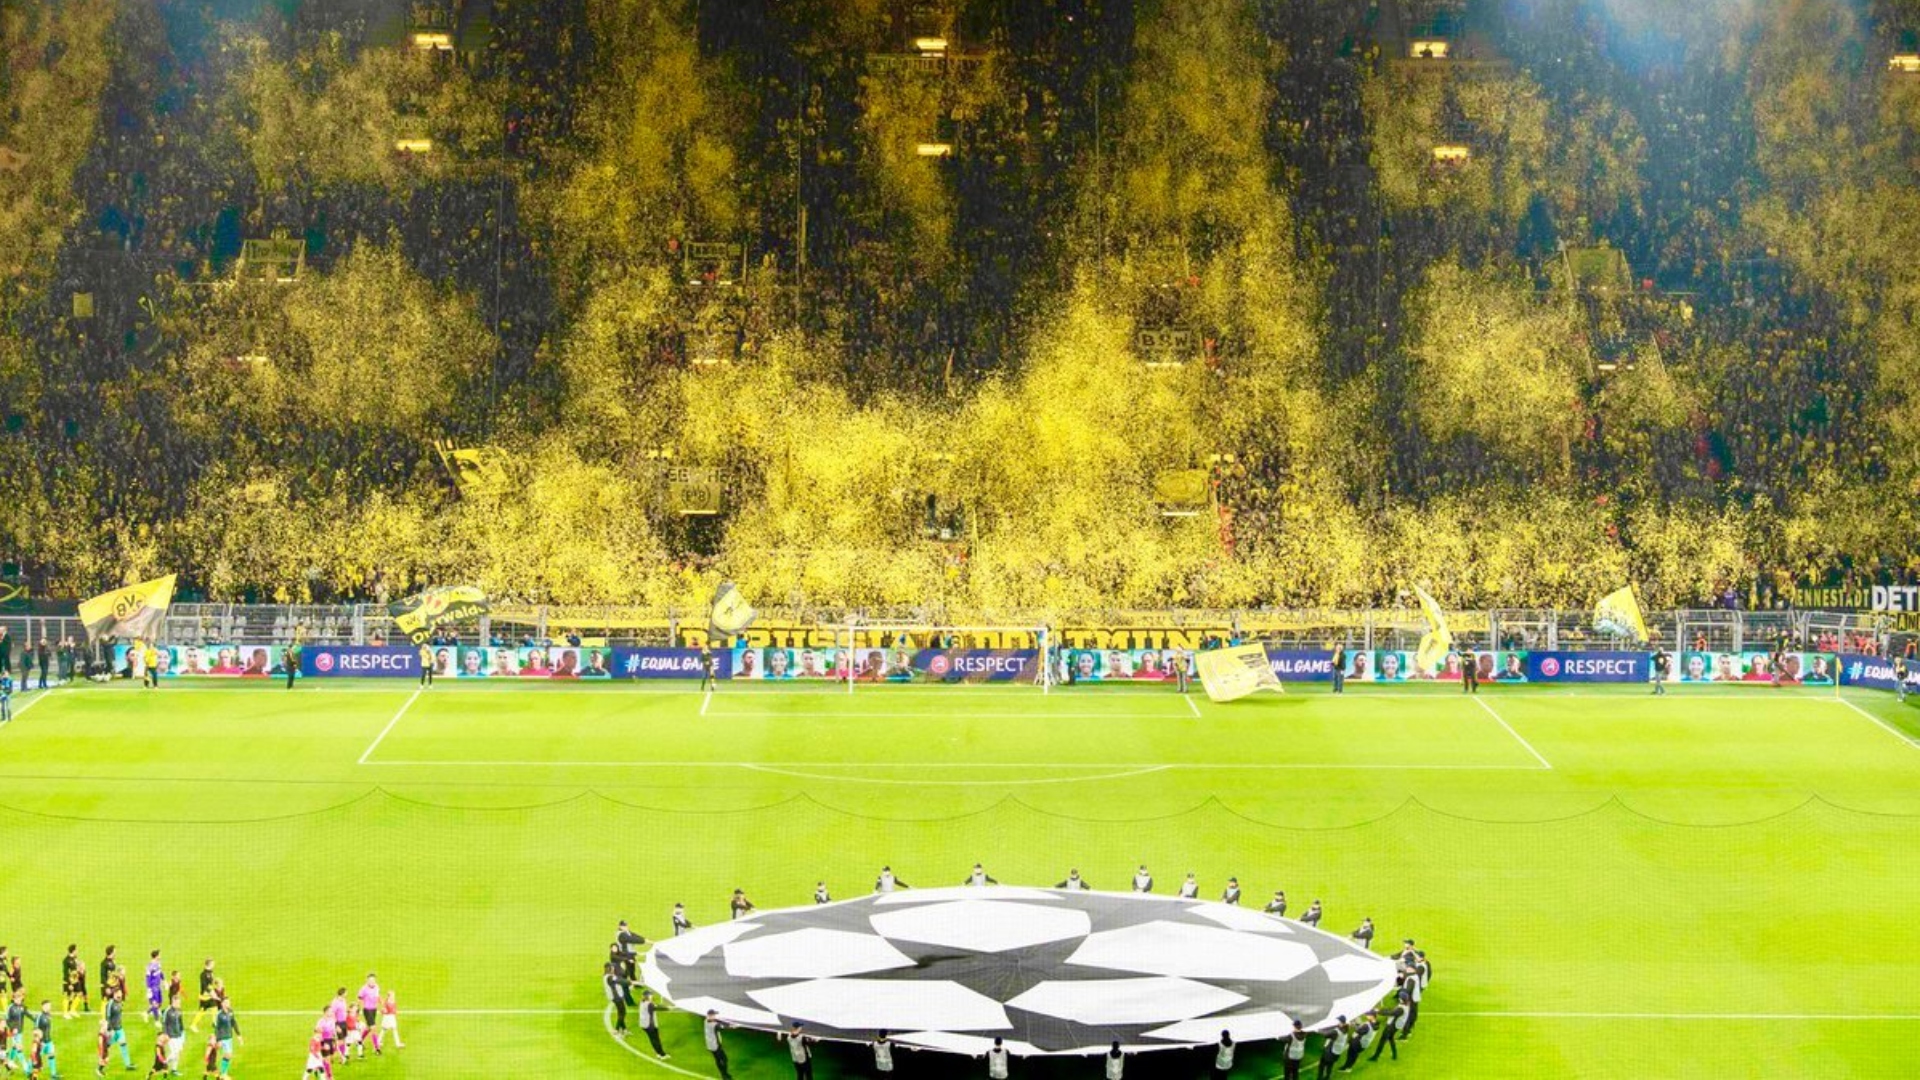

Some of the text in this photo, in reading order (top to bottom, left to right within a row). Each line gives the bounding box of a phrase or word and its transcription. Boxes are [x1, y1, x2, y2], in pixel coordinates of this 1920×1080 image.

[1796, 588, 1869, 607] ENNESTADT
[340, 654, 412, 669] RESPECT
[625, 653, 720, 673] #EQUAL GAE
[954, 657, 1027, 672] RESPECT
[1294, 659, 1331, 673] GAME
[1564, 659, 1637, 675] RESPECT
